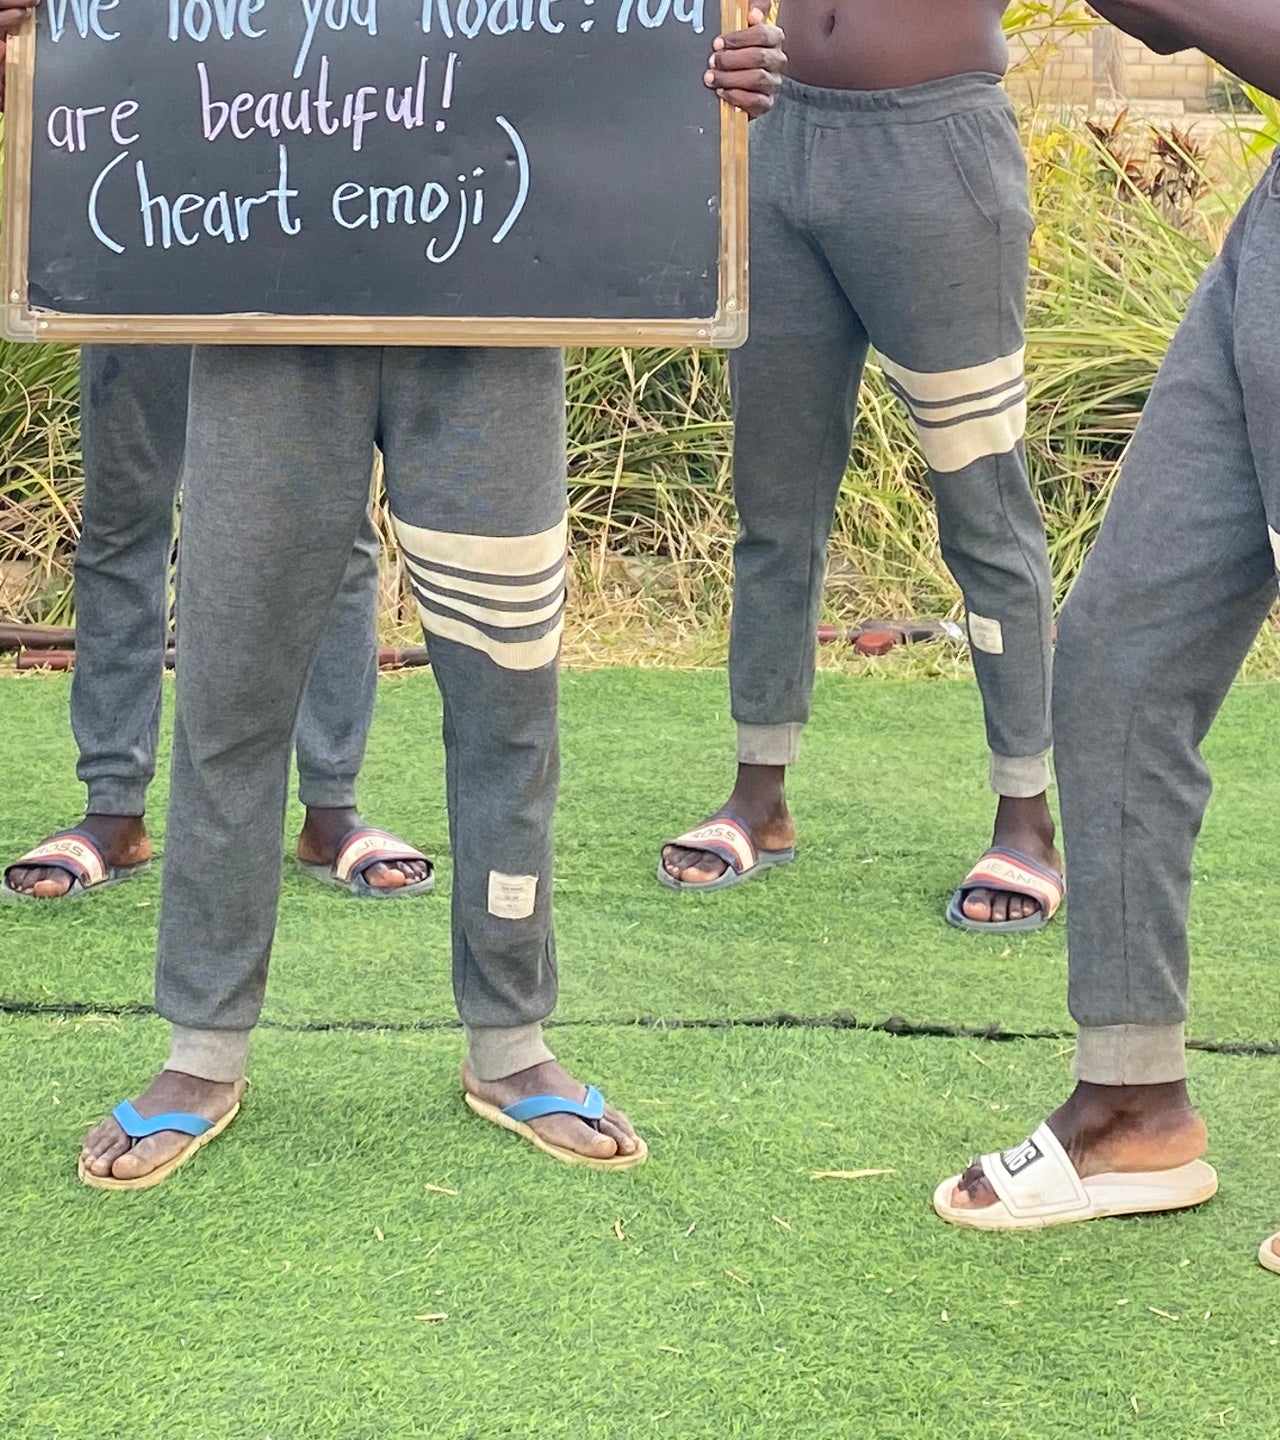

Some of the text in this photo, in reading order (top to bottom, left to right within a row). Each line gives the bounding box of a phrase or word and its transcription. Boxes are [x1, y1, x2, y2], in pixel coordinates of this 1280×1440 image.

[46, 52, 457, 153] are beautiful!
[87, 117, 531, 264] (heart emoji)
